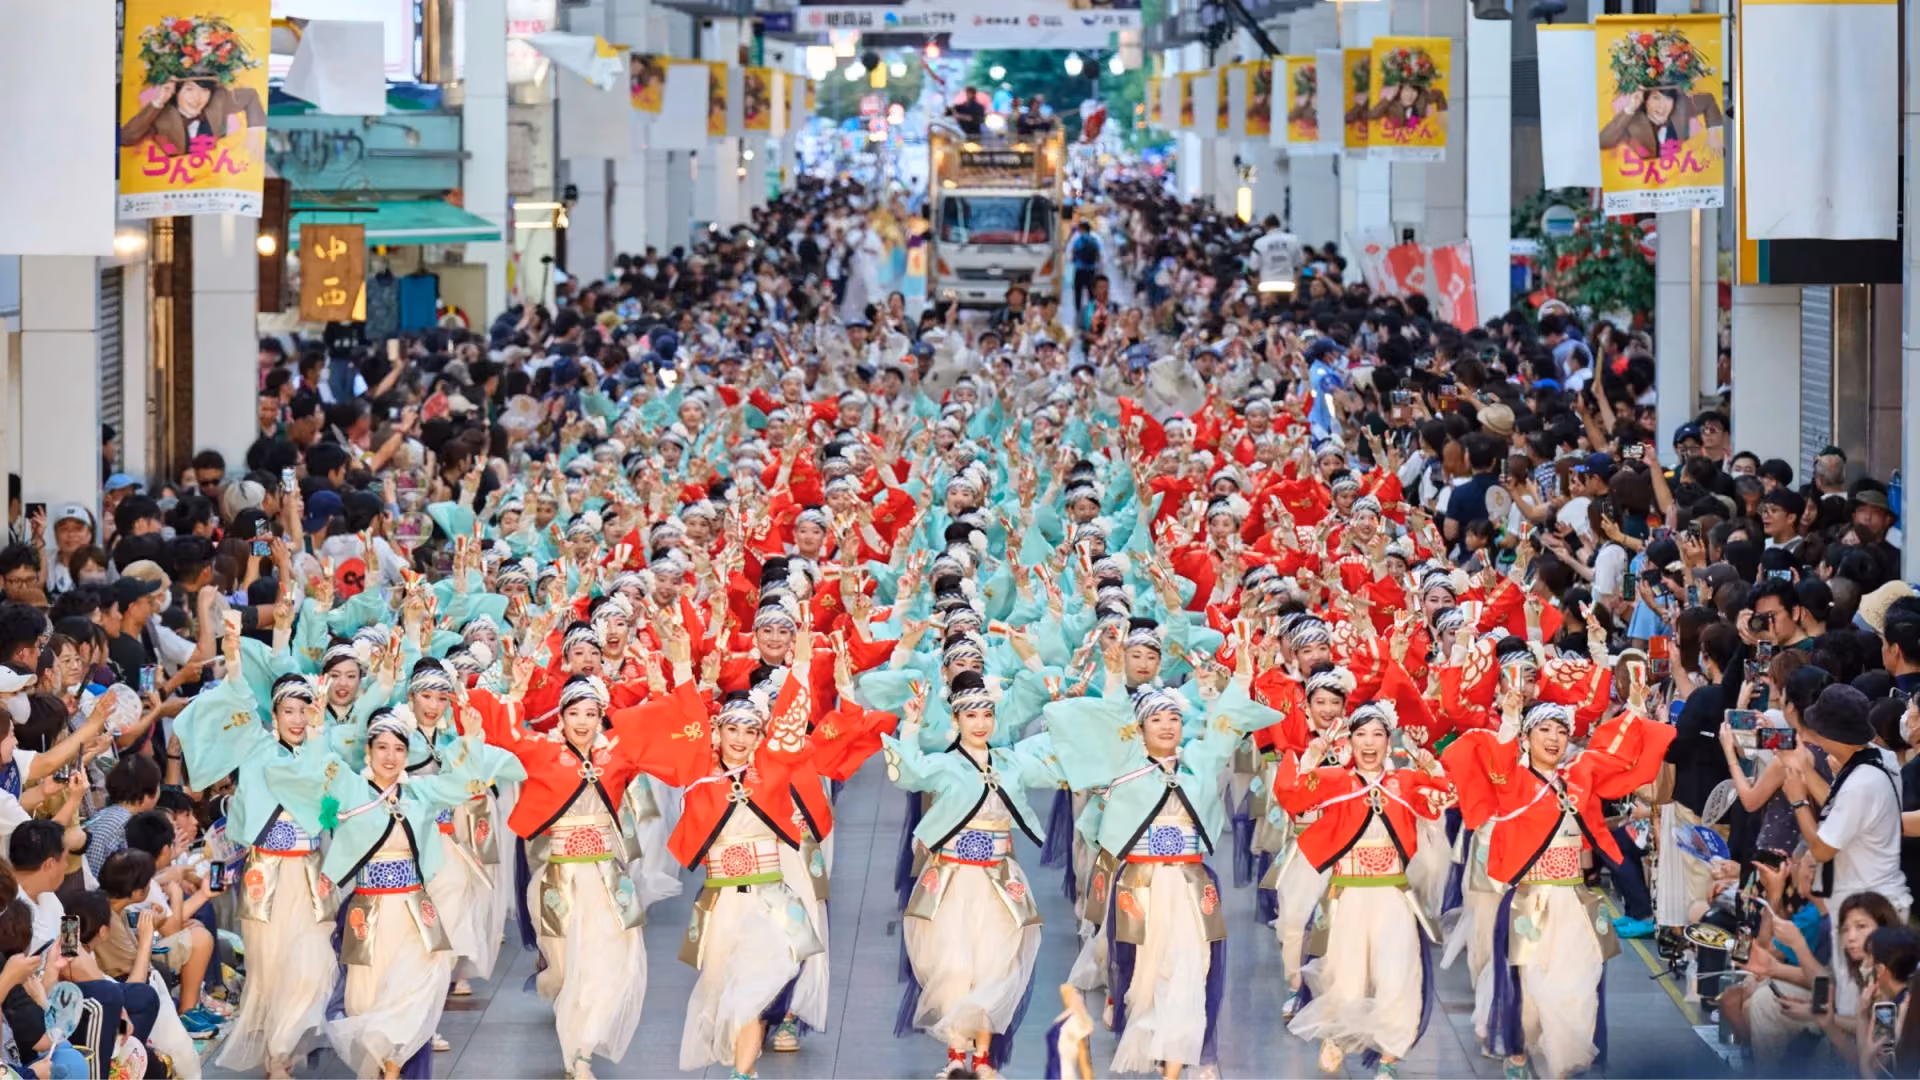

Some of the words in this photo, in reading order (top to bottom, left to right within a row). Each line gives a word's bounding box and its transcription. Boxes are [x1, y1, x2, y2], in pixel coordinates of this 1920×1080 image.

[142, 134, 242, 184] らんまん
[1618, 137, 1706, 185] らんまん
[314, 234, 348, 307] 中西
